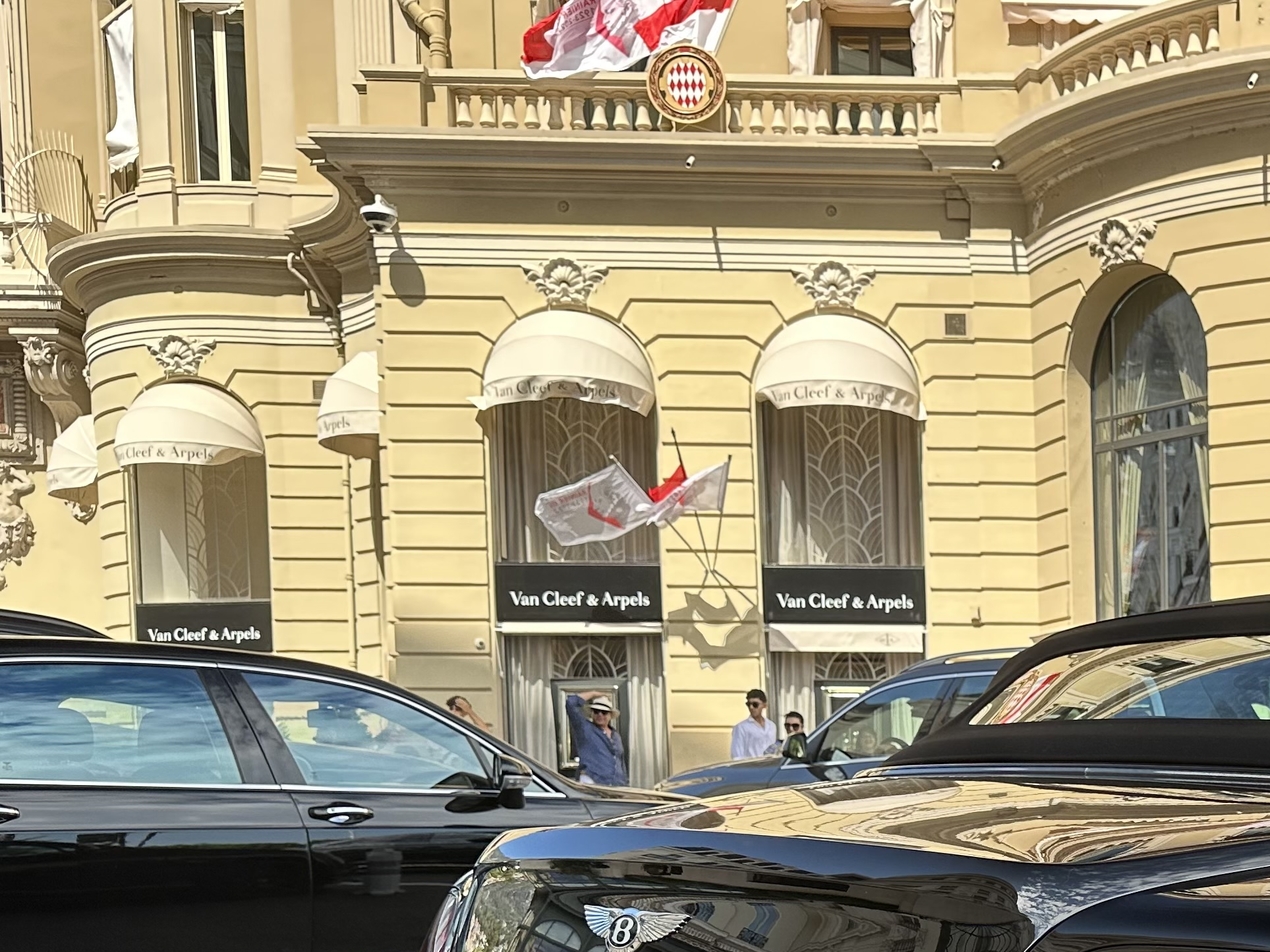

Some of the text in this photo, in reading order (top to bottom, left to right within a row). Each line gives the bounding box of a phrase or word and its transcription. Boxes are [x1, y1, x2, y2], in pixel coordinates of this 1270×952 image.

[794, 384, 831, 399] Cleef
[835, 389, 845, 399] &
[851, 386, 892, 403] Arpels
[125, 445, 154, 460] Cleef
[156, 447, 165, 457] &
[171, 446, 214, 462] Arpels
[508, 590, 651, 611] Van Cleef & Arpels
[776, 593, 914, 614] Van Cleef & Arpels
[147, 626, 261, 644] Van Cleef & Arpels
[611, 917, 634, 945] B
